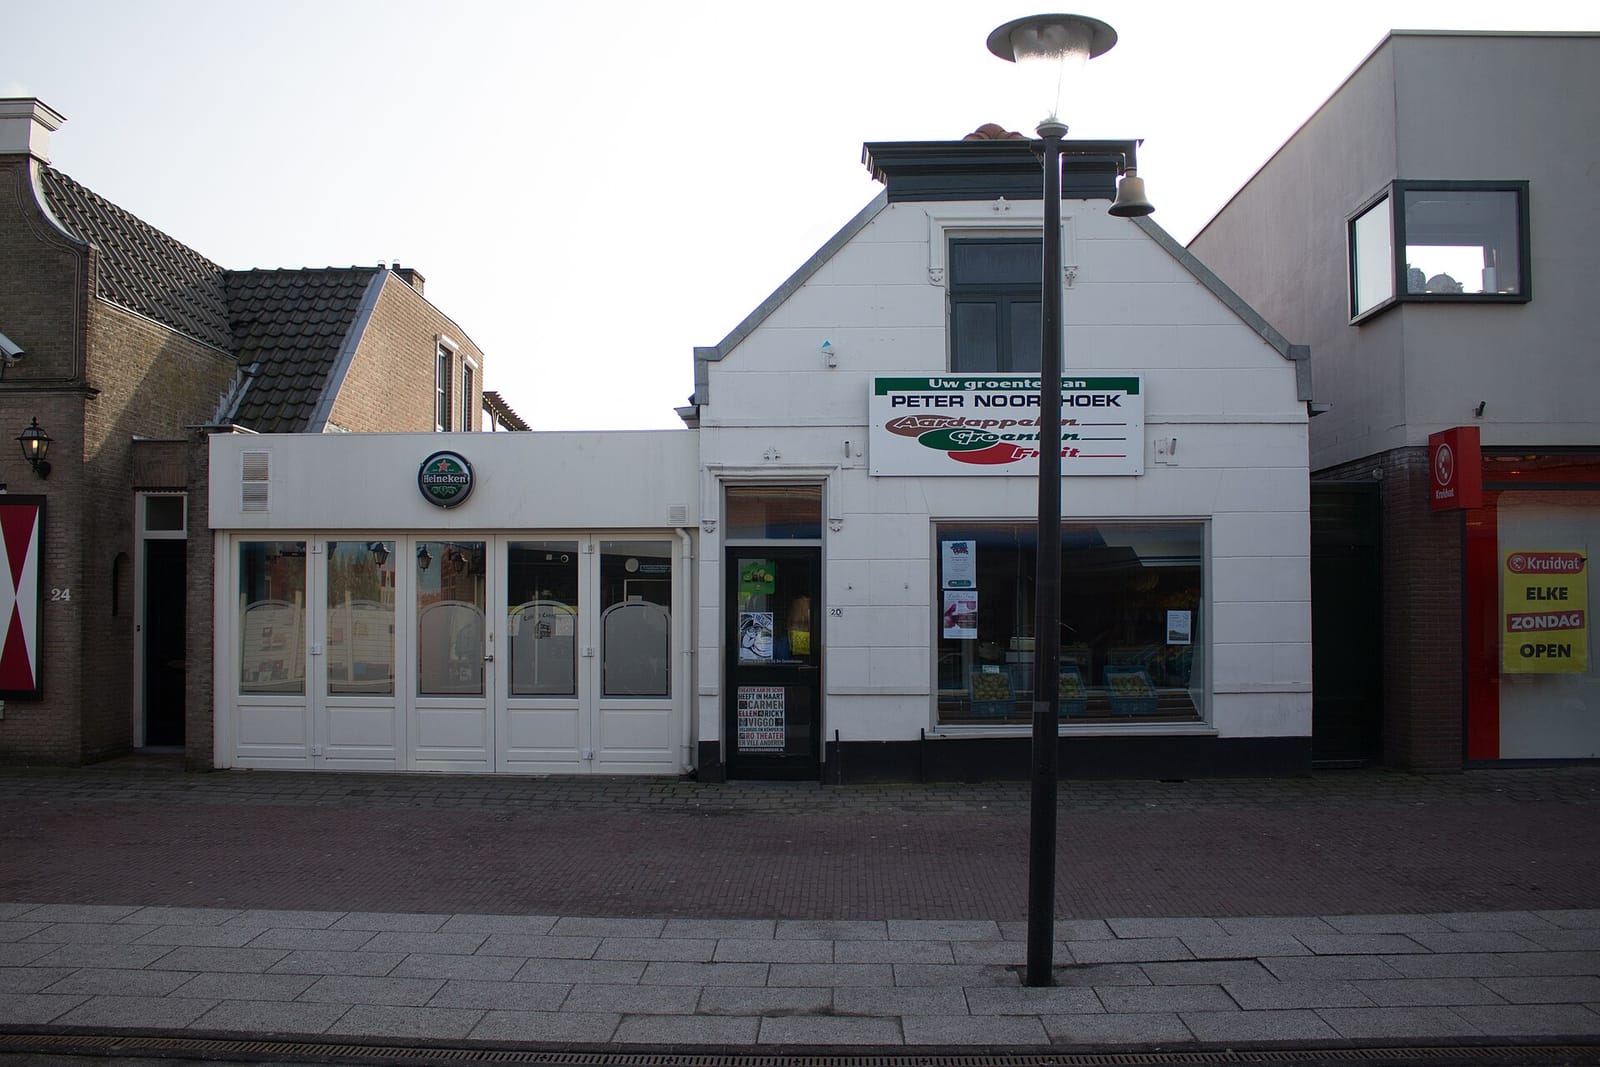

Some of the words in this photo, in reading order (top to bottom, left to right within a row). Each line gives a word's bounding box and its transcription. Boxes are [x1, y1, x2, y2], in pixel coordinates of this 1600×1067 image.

[929, 379, 959, 388] Uw
[964, 379, 1086, 391] groentean
[891, 395, 964, 407] PETER
[974, 395, 1122, 407] NOORHOEK
[893, 415, 1080, 430] Aardappeln
[1011, 446, 1080, 458] Frit
[424, 474, 466, 483] Heineken
[1527, 557, 1580, 570] Kruidvat
[51, 588, 71, 601] 24
[1526, 587, 1568, 600] ELKE
[1511, 614, 1580, 630] ZONDAG
[1520, 644, 1571, 658] OPEN
[748, 700, 784, 709] CARMEN
[748, 718, 774, 726] VIGGO
